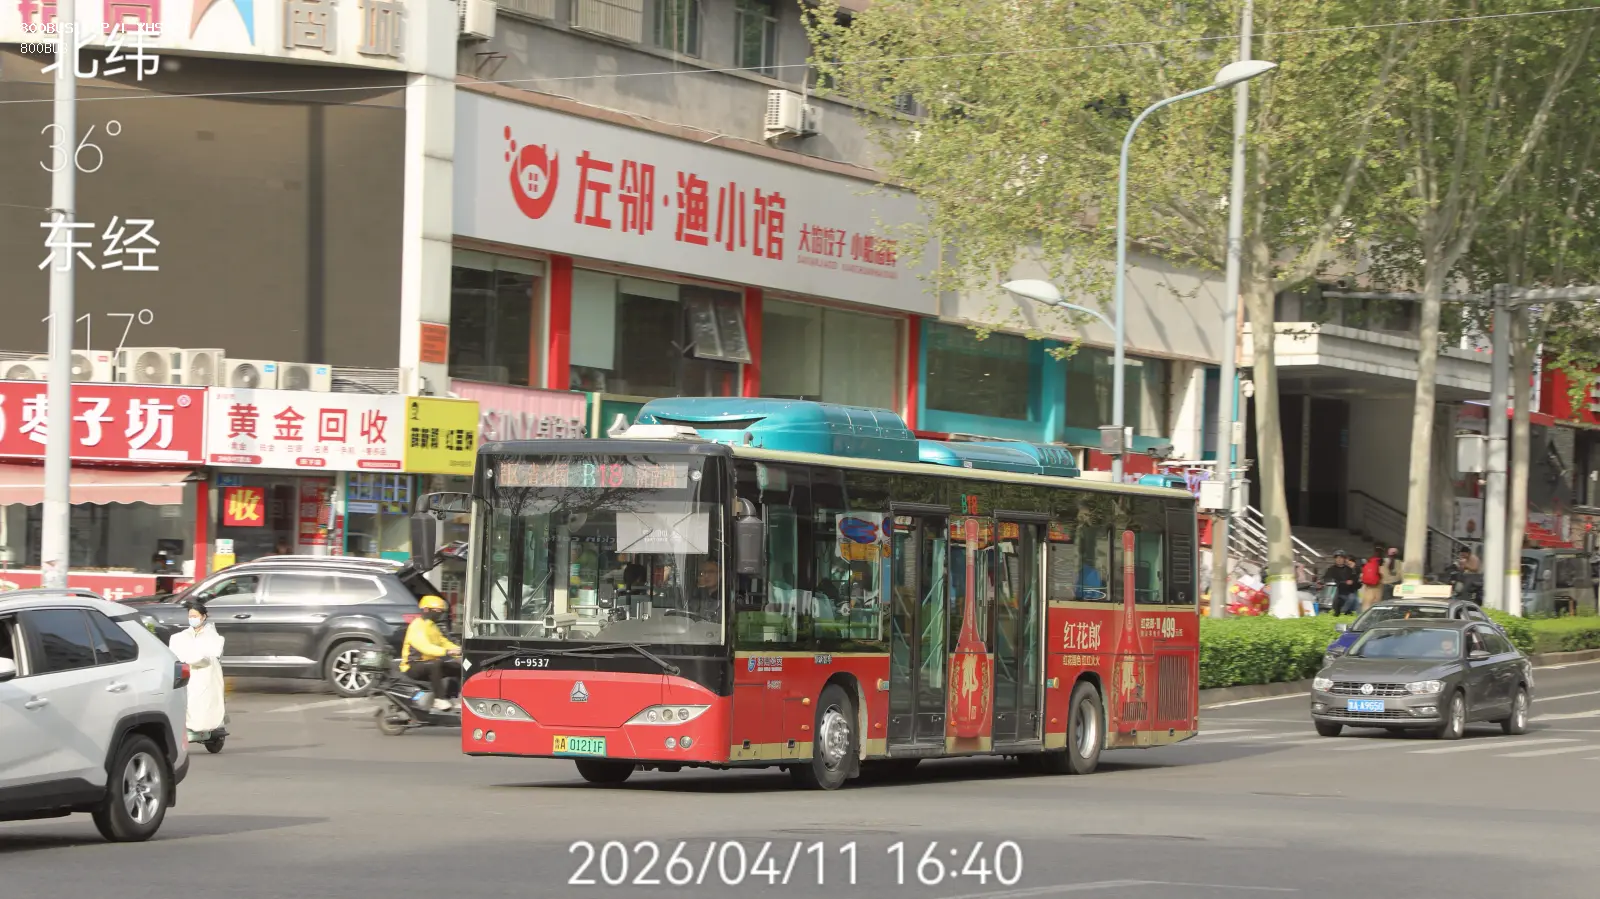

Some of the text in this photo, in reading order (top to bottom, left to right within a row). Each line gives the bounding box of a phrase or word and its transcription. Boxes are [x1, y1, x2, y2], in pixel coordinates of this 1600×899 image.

[0, 391, 175, 451] 枣子坊
[227, 402, 389, 445] 黄金回收
[582, 463, 624, 488] B18
[228, 489, 261, 521] 收
[1064, 620, 1102, 652] 红花郎
[1161, 617, 1175, 640] 499
[514, 658, 550, 668] 6-9537
[569, 738, 604, 753] 01211F
